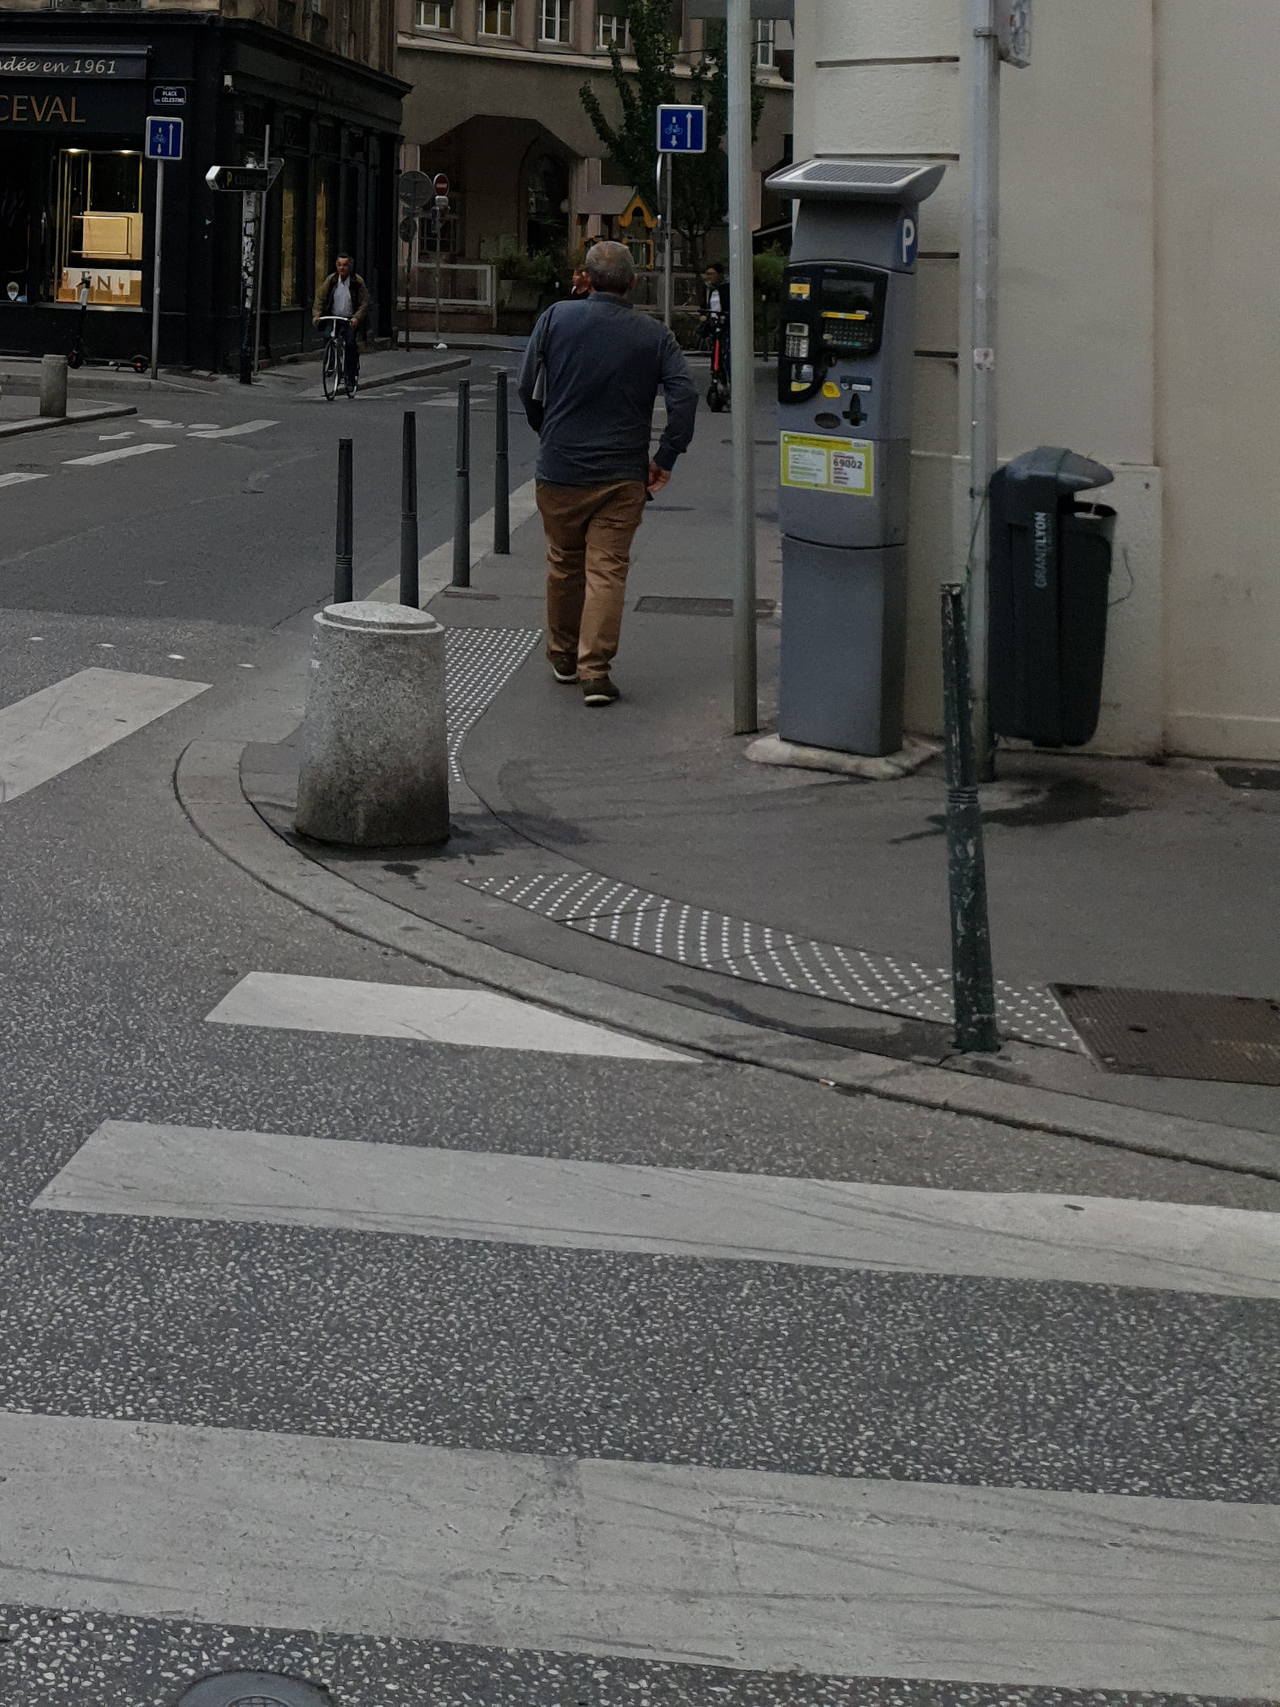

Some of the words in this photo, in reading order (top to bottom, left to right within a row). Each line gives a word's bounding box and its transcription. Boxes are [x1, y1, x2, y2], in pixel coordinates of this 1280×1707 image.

[43, 61, 70, 73] en
[72, 59, 117, 74] 1961
[903, 218, 915, 263] P
[833, 457, 863, 470] 69002
